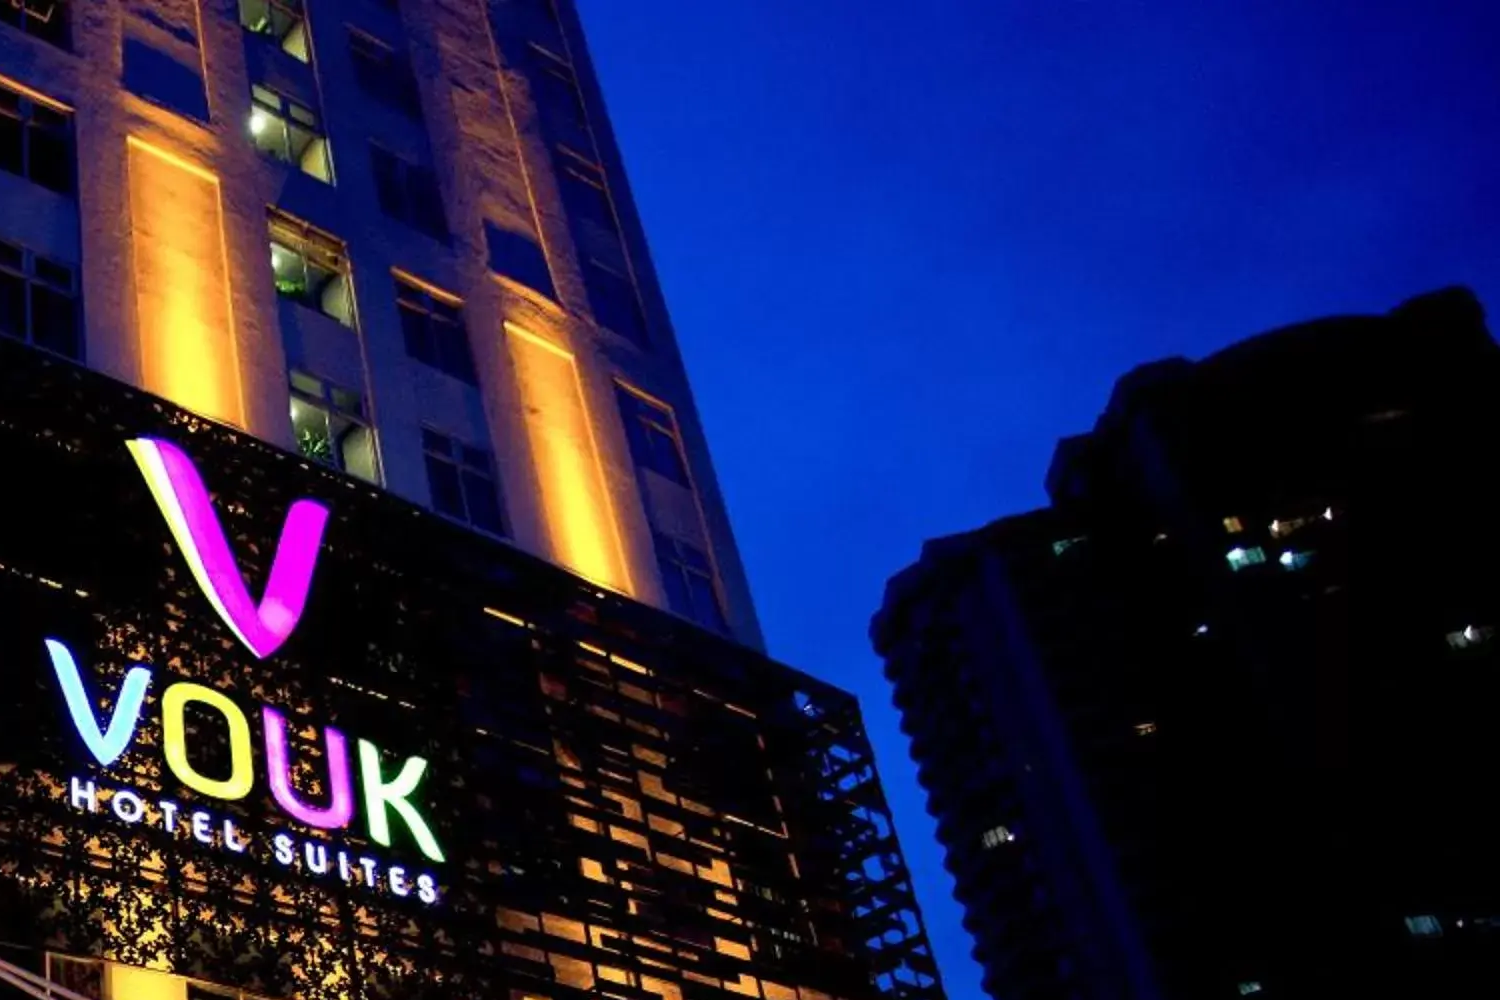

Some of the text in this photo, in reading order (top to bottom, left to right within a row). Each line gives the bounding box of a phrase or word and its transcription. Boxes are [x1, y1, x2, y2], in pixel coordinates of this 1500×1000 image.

[124, 437, 330, 659] V
[45, 638, 446, 862] VOUK
[71, 777, 438, 904] HOTEL SUITES
